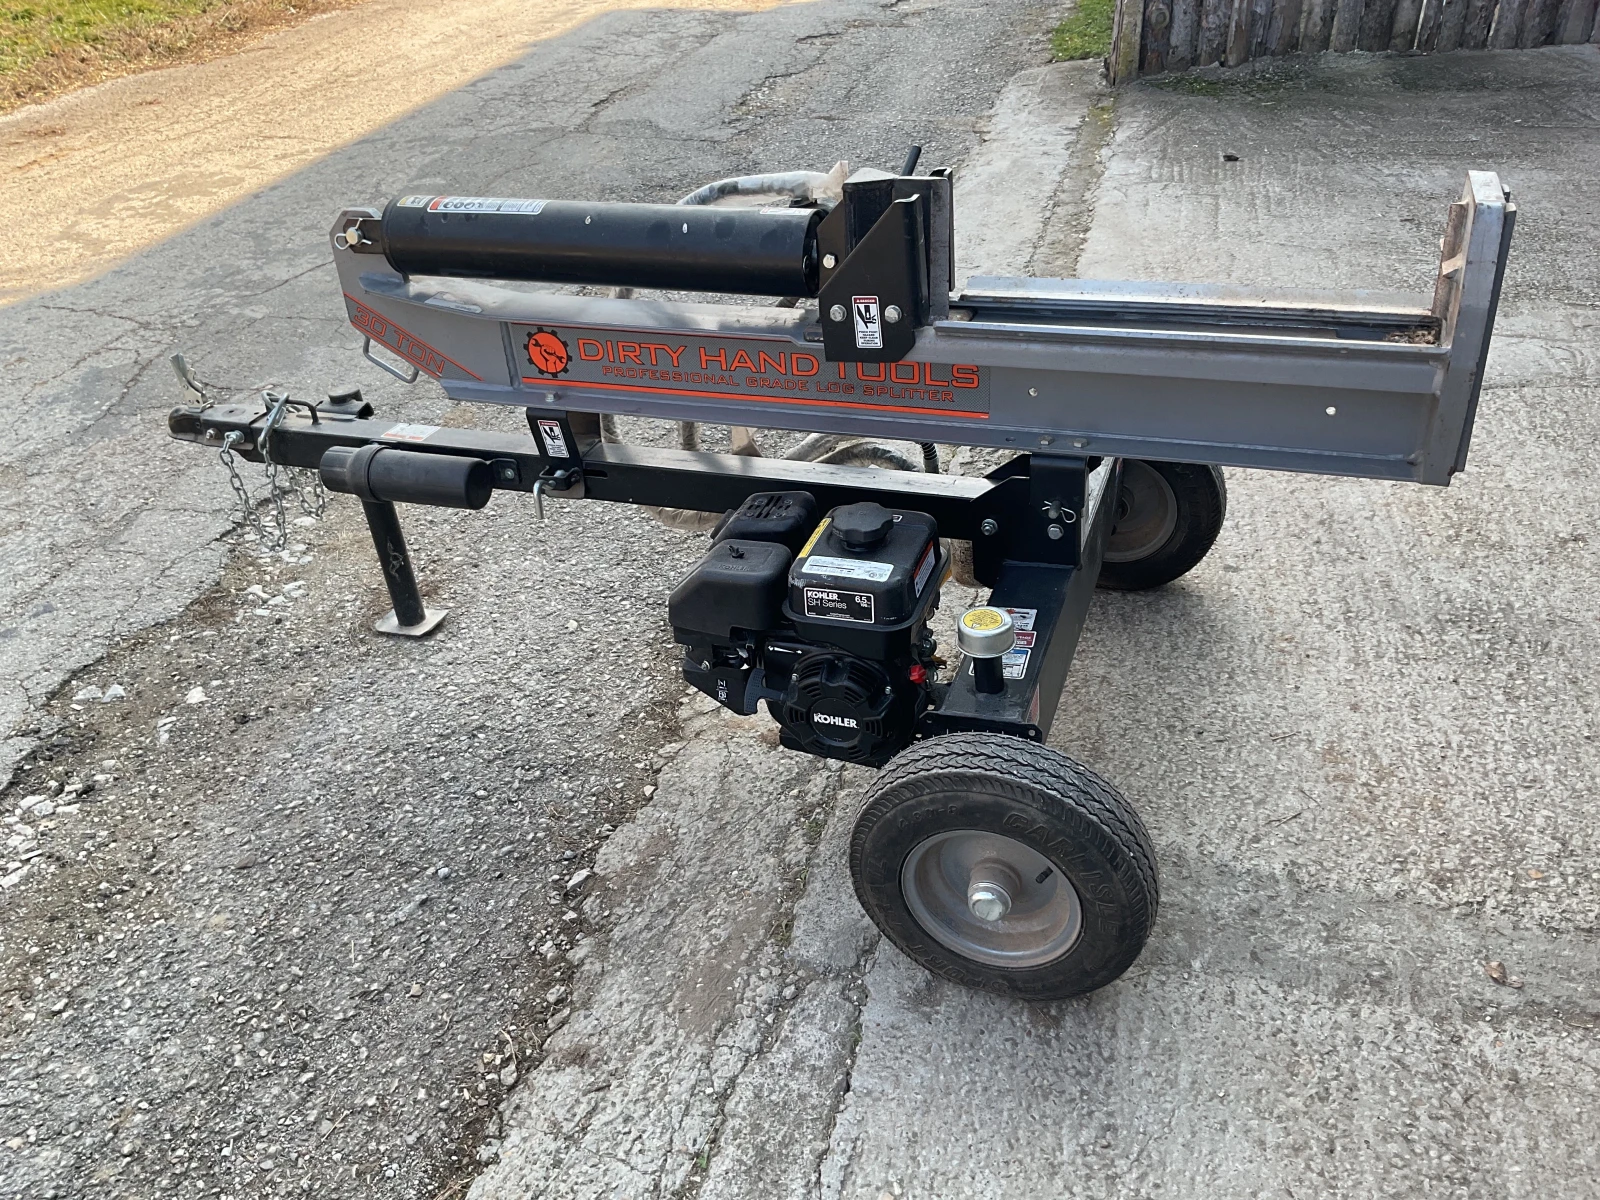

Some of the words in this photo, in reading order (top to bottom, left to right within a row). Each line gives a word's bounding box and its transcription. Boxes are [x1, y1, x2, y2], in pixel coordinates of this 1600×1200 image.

[353, 306, 387, 337] 30
[394, 329, 445, 374] TON
[577, 338, 687, 367] DIRTY
[698, 346, 819, 376] HAND
[602, 365, 740, 387] PROFESSIONAL
[746, 376, 808, 391] GRADE
[816, 381, 854, 394] LOG
[863, 384, 954, 403] SPLITTER
[807, 591, 839, 601] KOHLER
[807, 597, 821, 607] SH
[822, 600, 847, 610] Series
[813, 712, 859, 729] KOHLER
[1001, 812, 1121, 938] CARLISLE
